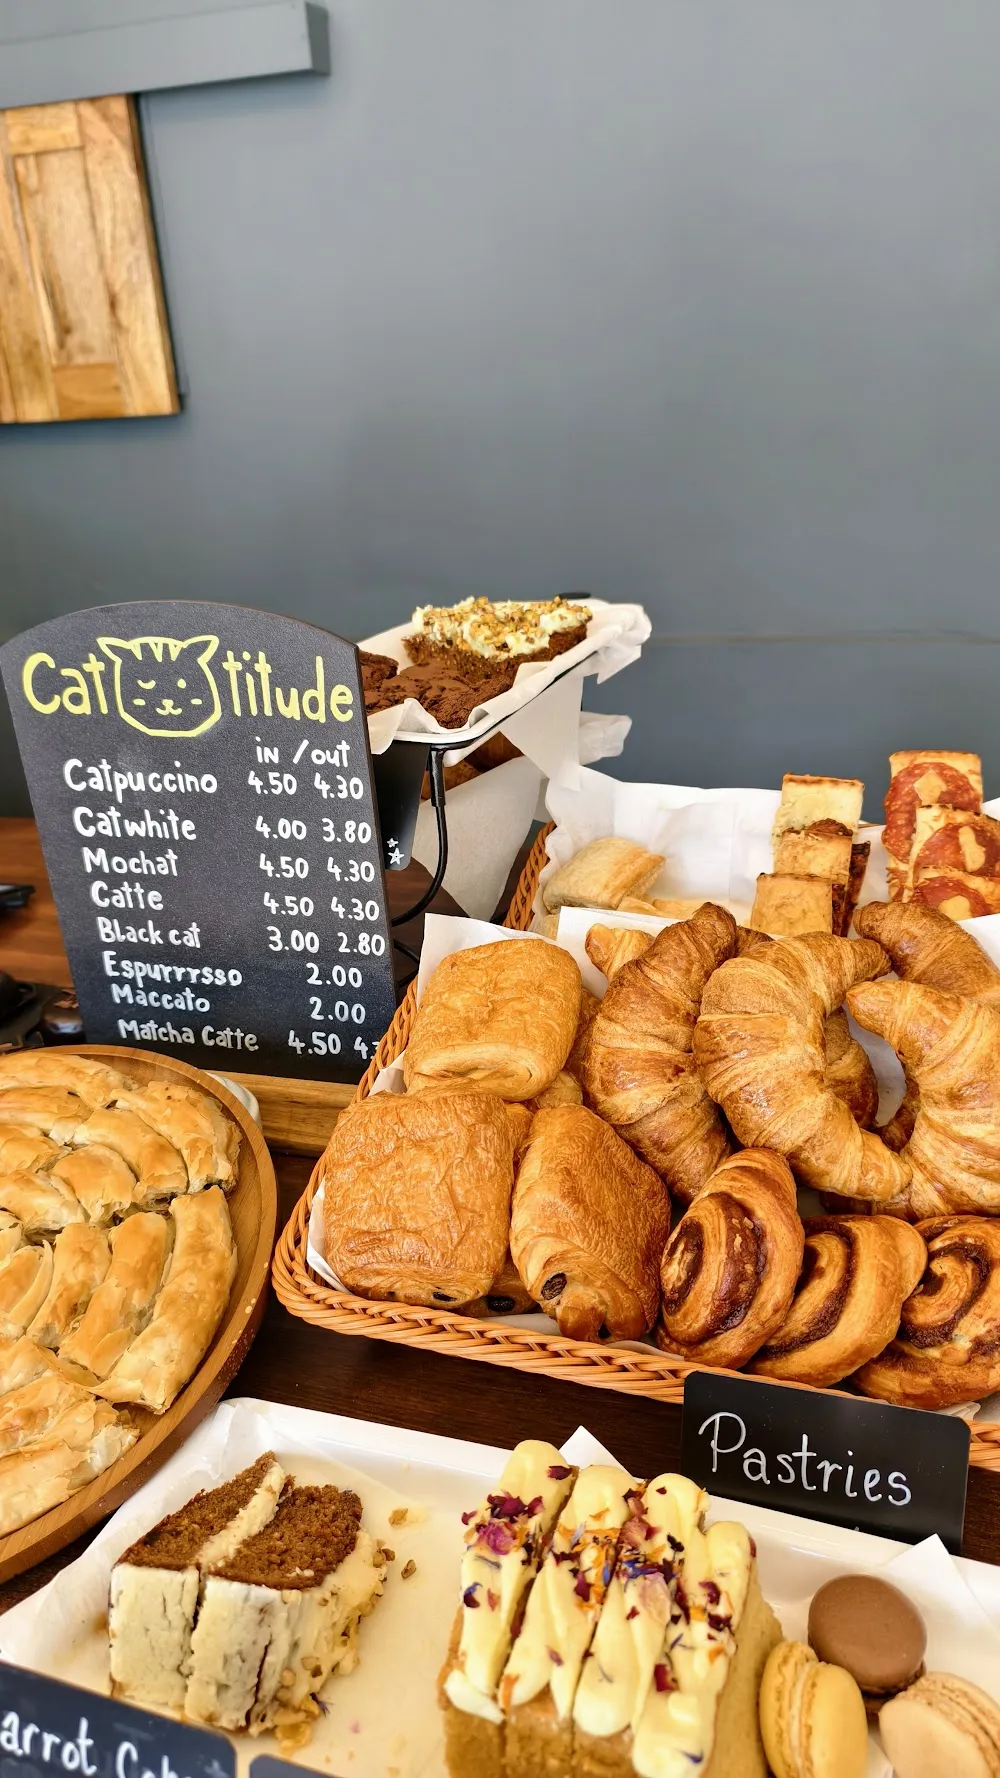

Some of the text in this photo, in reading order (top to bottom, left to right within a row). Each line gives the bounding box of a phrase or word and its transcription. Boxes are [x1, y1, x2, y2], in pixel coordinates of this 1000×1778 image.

[22, 650, 354, 724] Cat titude
[255, 736, 280, 765] in
[63, 757, 364, 803] Catpuccino 4.50 4.30
[73, 805, 372, 844] Catwhite 4.00 3.80
[82, 846, 376, 883] Mochat 4.50 4.30
[90, 880, 380, 922] Catte 4.50 4.30
[97, 916, 386, 957] Black cat 3.00 2.80
[101, 950, 363, 989] Espurrrsso 2.00
[111, 983, 366, 1025] Maccato 2.00
[118, 1018, 380, 1061] Matcha Catte 4.50 4.
[698, 1411, 912, 1506] Pastries
[0, 1711, 98, 1777] arrot
